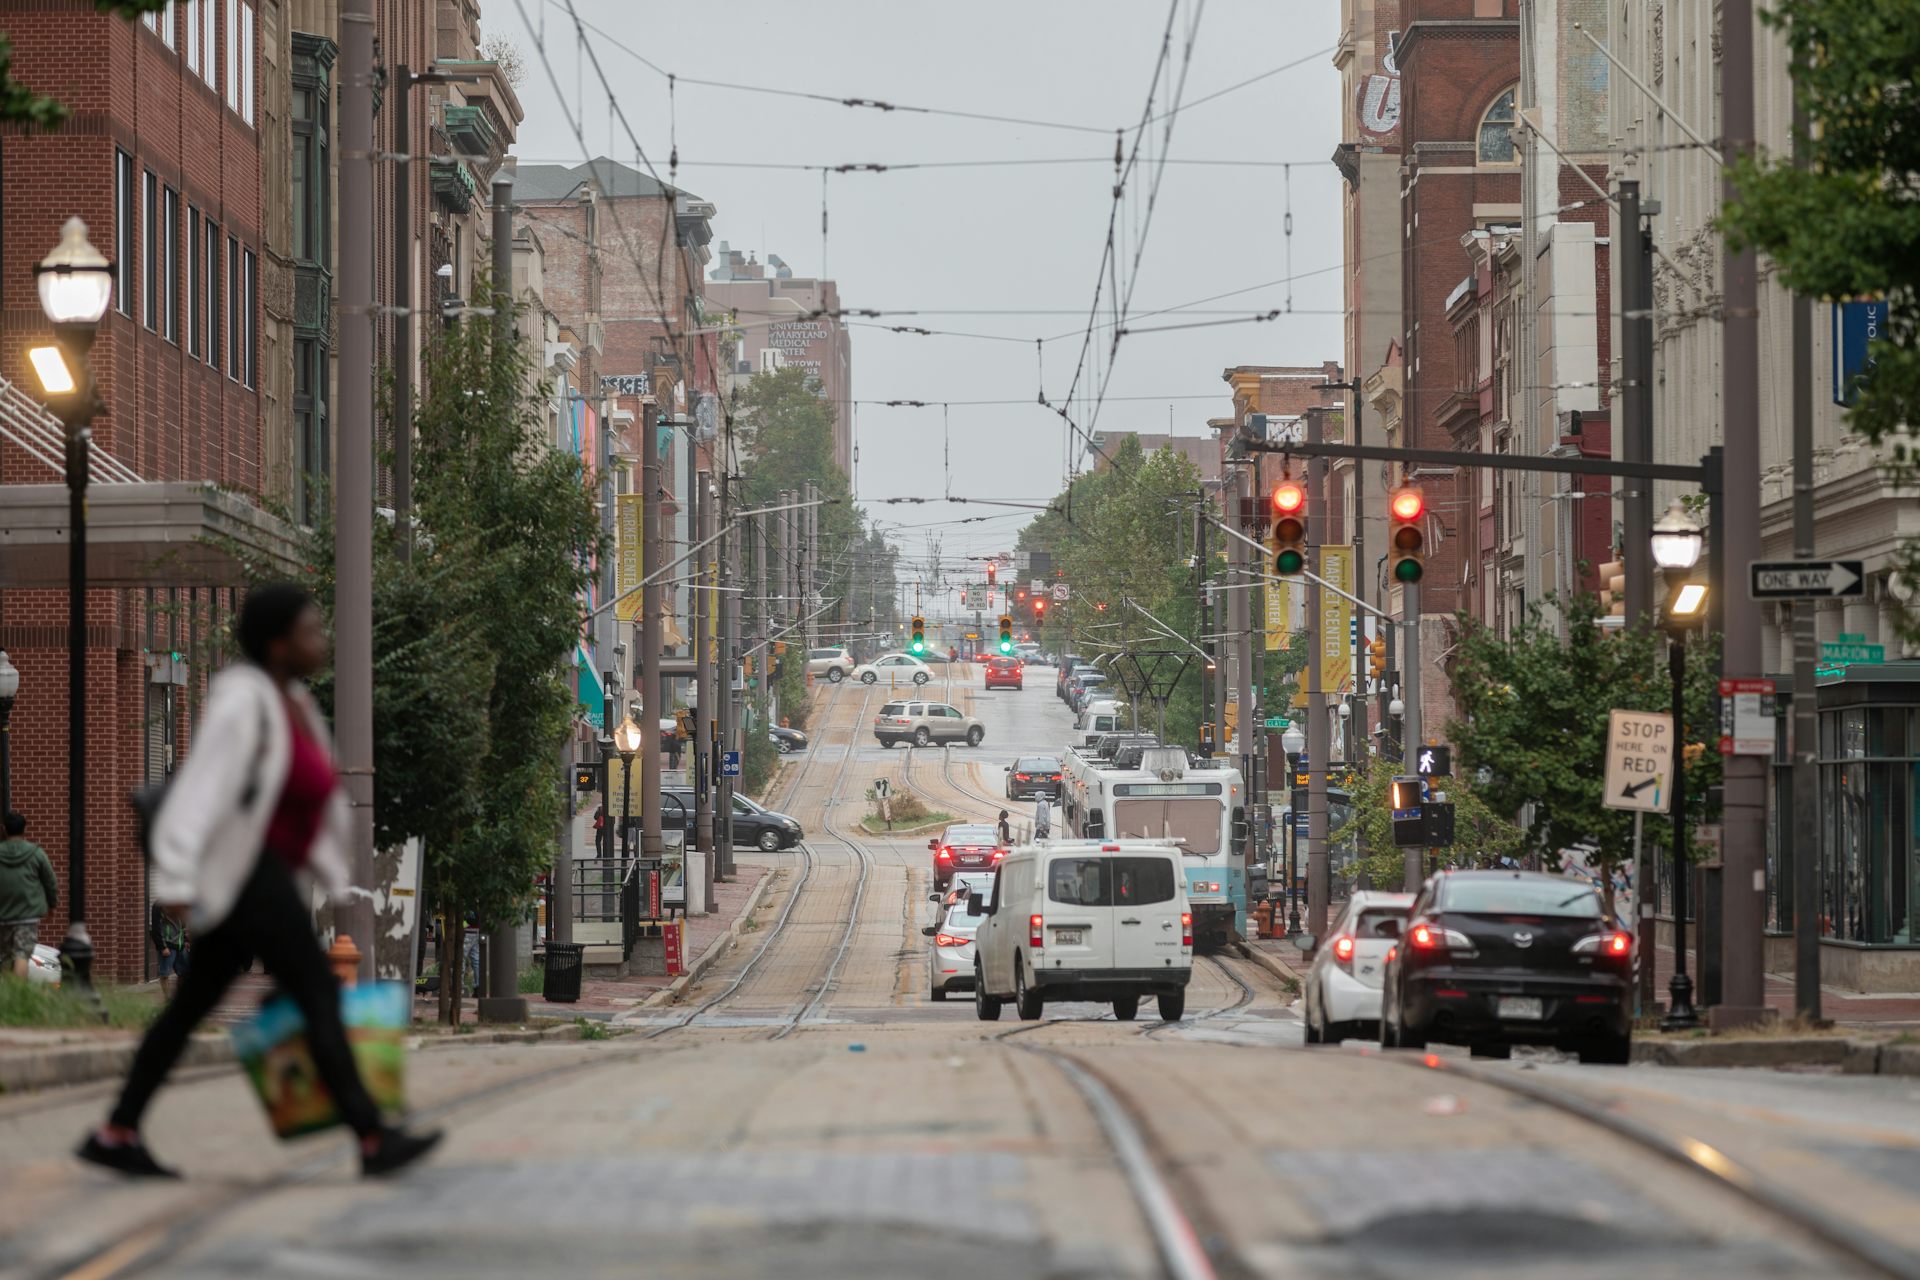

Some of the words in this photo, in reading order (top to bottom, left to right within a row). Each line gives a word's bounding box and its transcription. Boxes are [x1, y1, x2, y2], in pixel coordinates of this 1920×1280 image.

[769, 321, 822, 330] UNIVERSITY
[775, 330, 828, 339] MARYLAND
[769, 339, 811, 347] MEDICAL
[780, 348, 806, 356] NTER
[623, 504, 636, 547] MARKET
[1762, 572, 1793, 588] ONE
[1797, 572, 1830, 587] WAY
[1268, 586, 1281, 625] CENTER
[1325, 609, 1340, 658] CENTER
[1823, 645, 1870, 659] MARION
[1621, 721, 1666, 739] STOP
[1616, 741, 1644, 753] HERE
[1652, 744, 1668, 754] ON
[1623, 756, 1657, 773] RED
